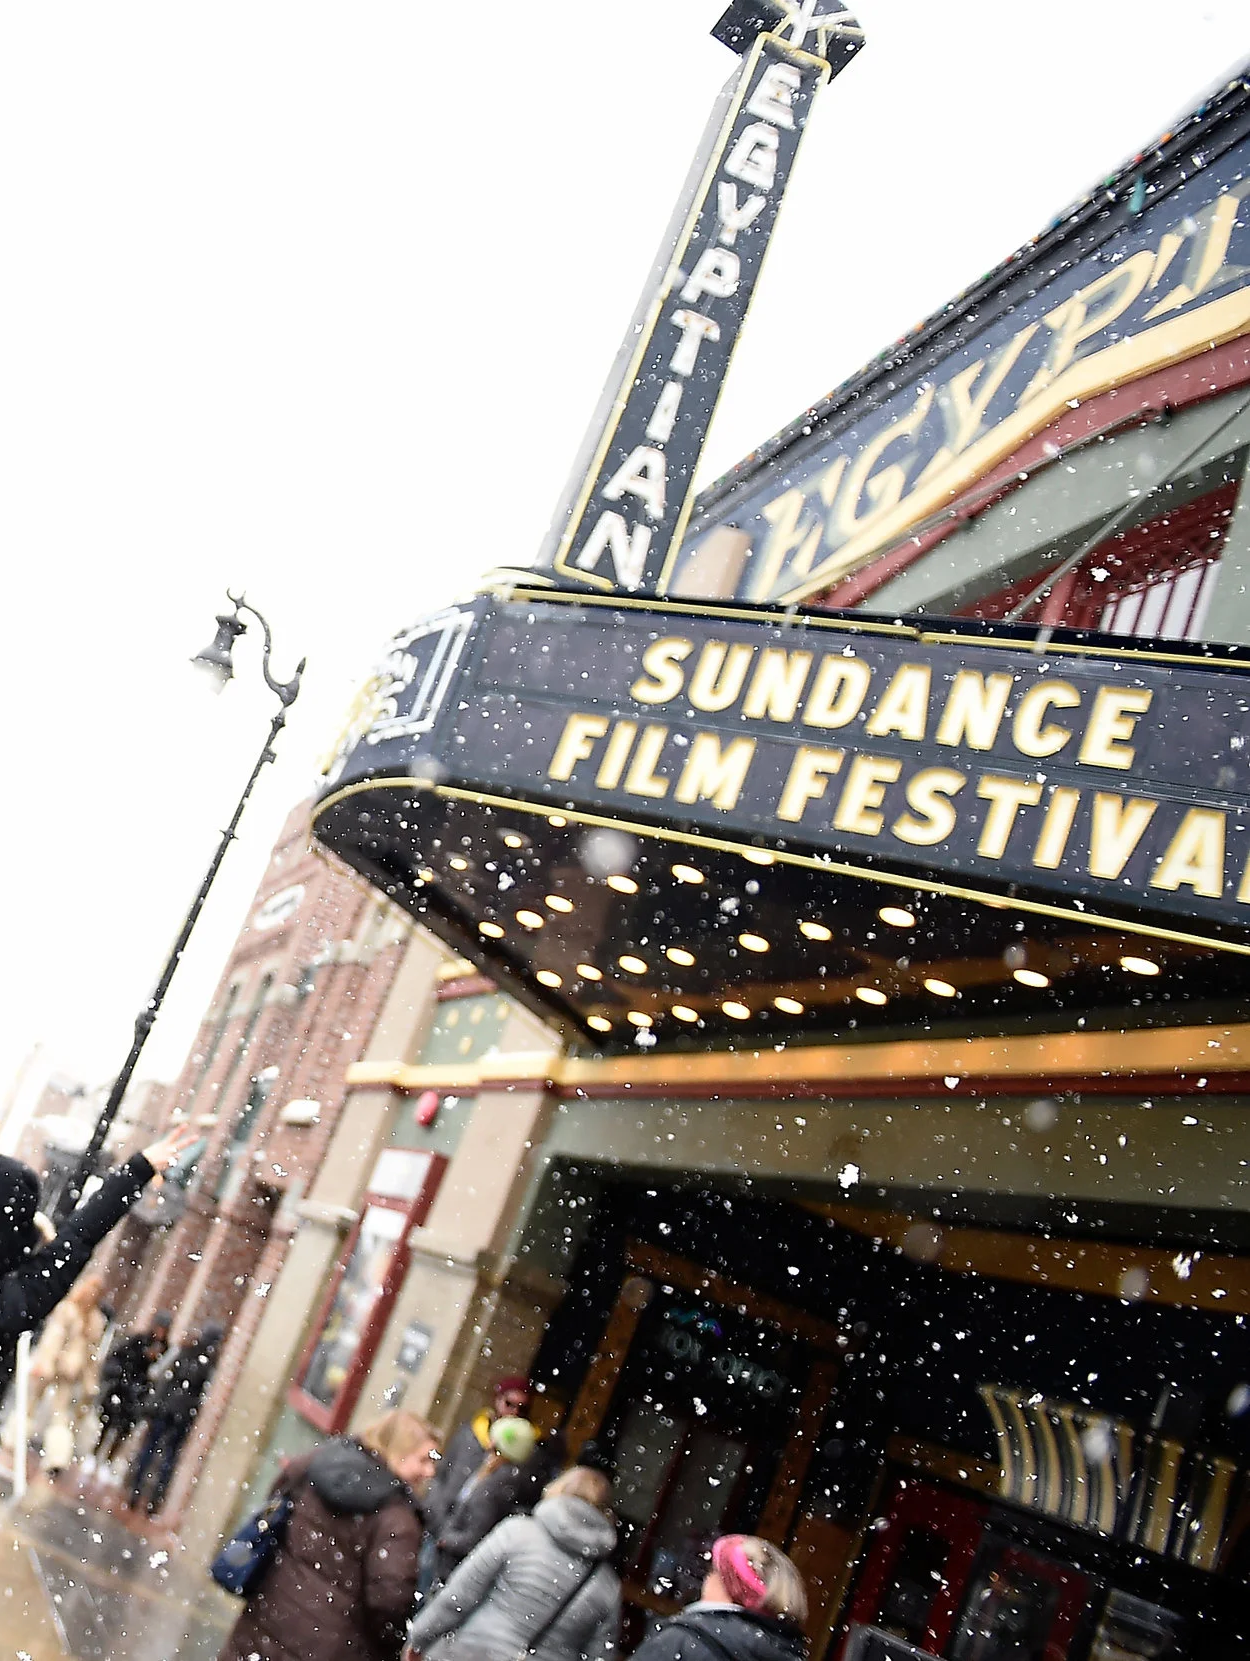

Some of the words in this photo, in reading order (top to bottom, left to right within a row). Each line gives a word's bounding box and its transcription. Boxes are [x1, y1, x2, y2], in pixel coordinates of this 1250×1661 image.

[575, 61, 803, 591] EGYPTIAN
[547, 712, 757, 811] FILM
[629, 636, 1153, 770] SUNDANCE
